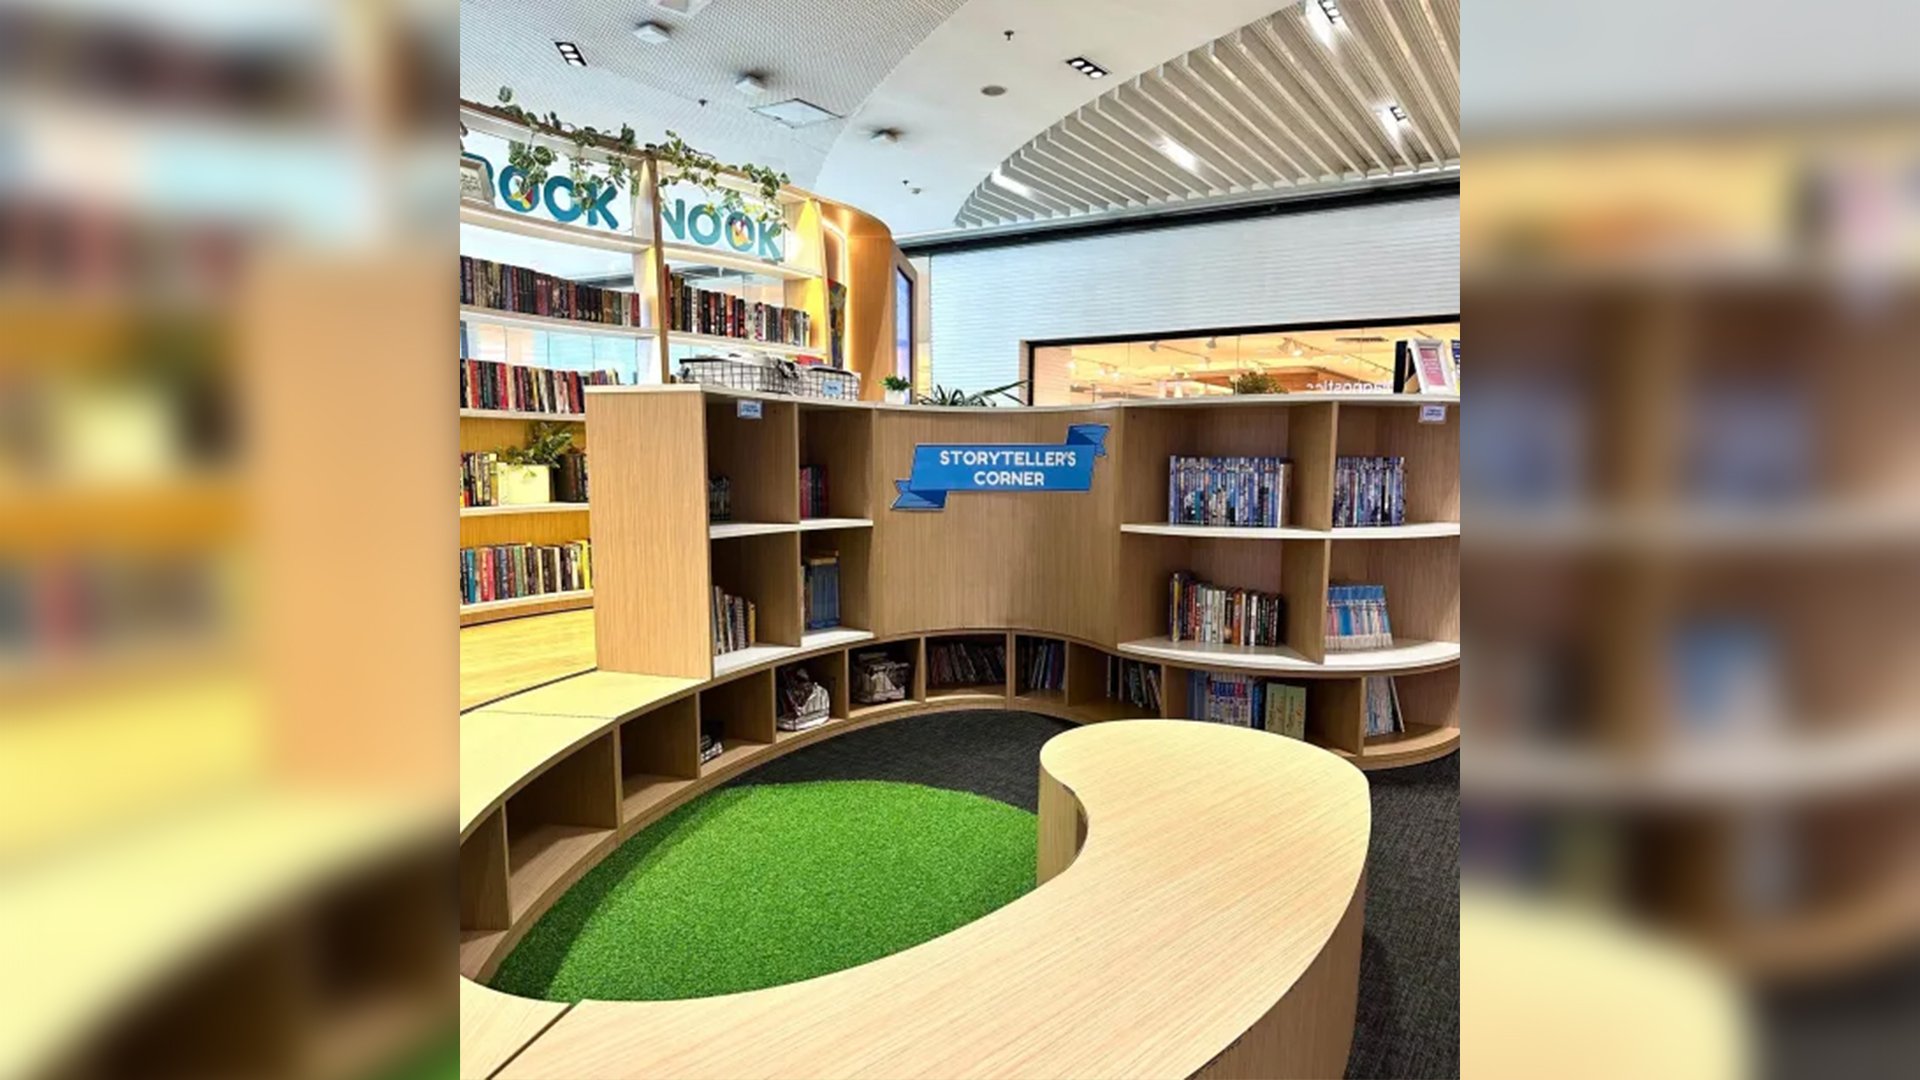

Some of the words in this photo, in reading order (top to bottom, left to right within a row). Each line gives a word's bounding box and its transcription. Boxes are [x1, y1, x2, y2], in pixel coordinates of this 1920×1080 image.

[661, 198, 782, 260] NOOK
[939, 450, 1077, 467] STORYTELLER'S
[973, 471, 1045, 487] CORNER
